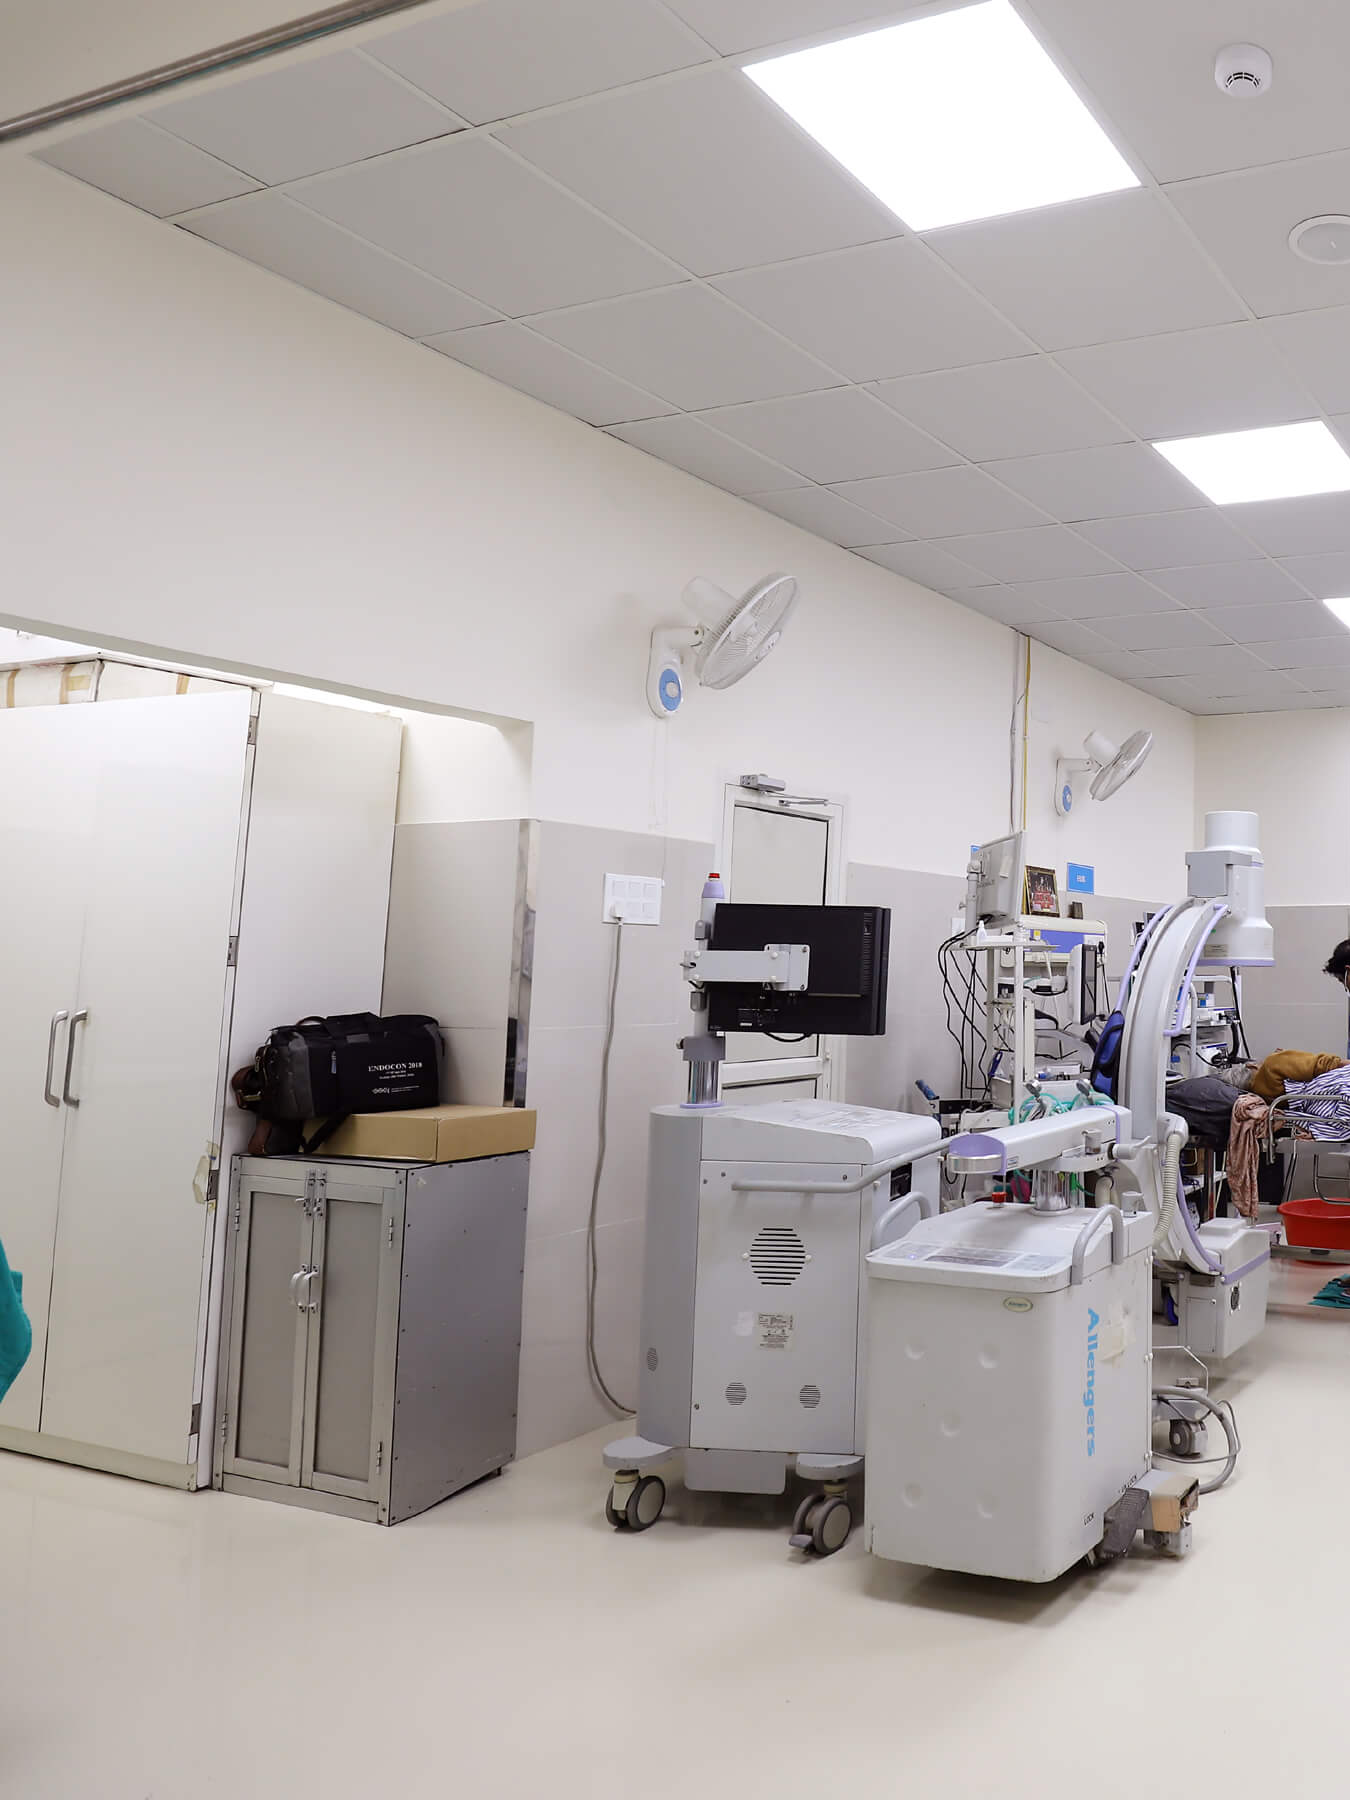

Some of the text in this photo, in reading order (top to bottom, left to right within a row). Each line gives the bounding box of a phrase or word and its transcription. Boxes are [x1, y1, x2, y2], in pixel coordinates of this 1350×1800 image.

[368, 1061, 423, 1072] ENDOCON 2018
[1082, 1307, 1100, 1457] Allengers
[1083, 1511, 1095, 1526] LOCK
